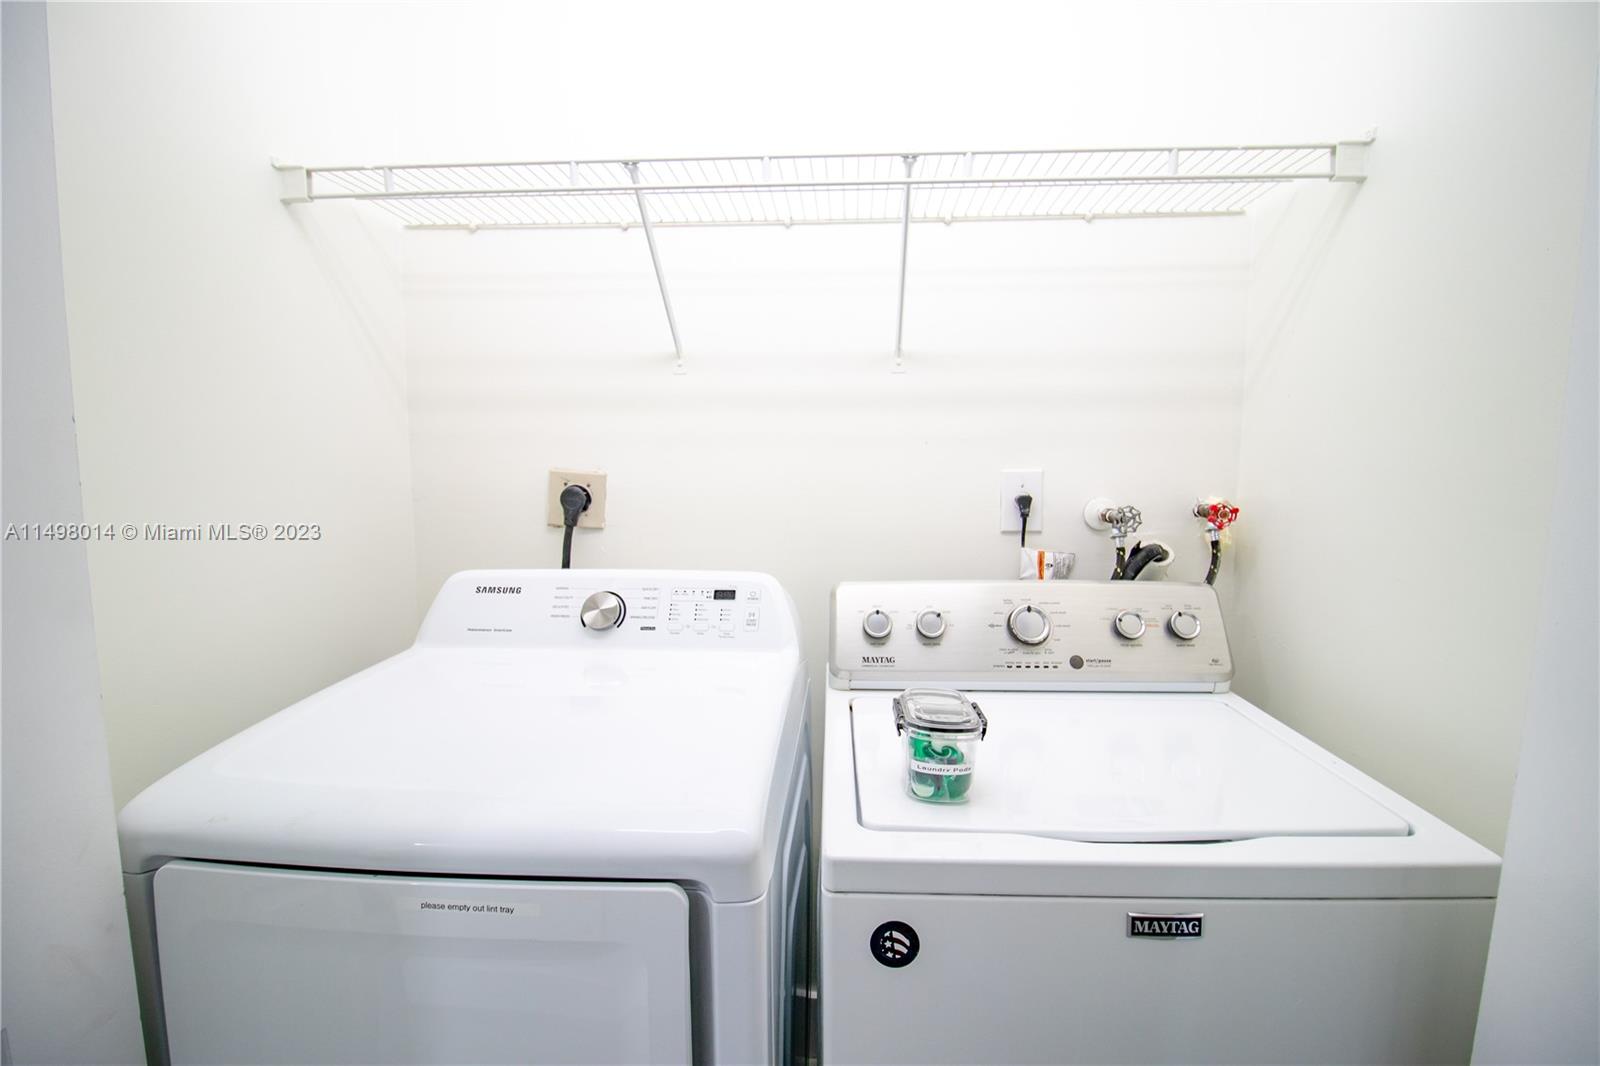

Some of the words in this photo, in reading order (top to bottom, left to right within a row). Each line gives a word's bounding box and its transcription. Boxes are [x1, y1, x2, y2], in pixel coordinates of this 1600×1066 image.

[475, 586, 522, 595] SAMSUNG
[861, 656, 896, 664] MAYTAG
[916, 764, 952, 773] Laundry
[420, 901, 446, 910] please
[447, 903, 471, 912] empty
[472, 904, 485, 912] out
[486, 904, 498, 913] lint
[499, 905, 515, 914] tray
[1133, 920, 1200, 934] MAYTAG
